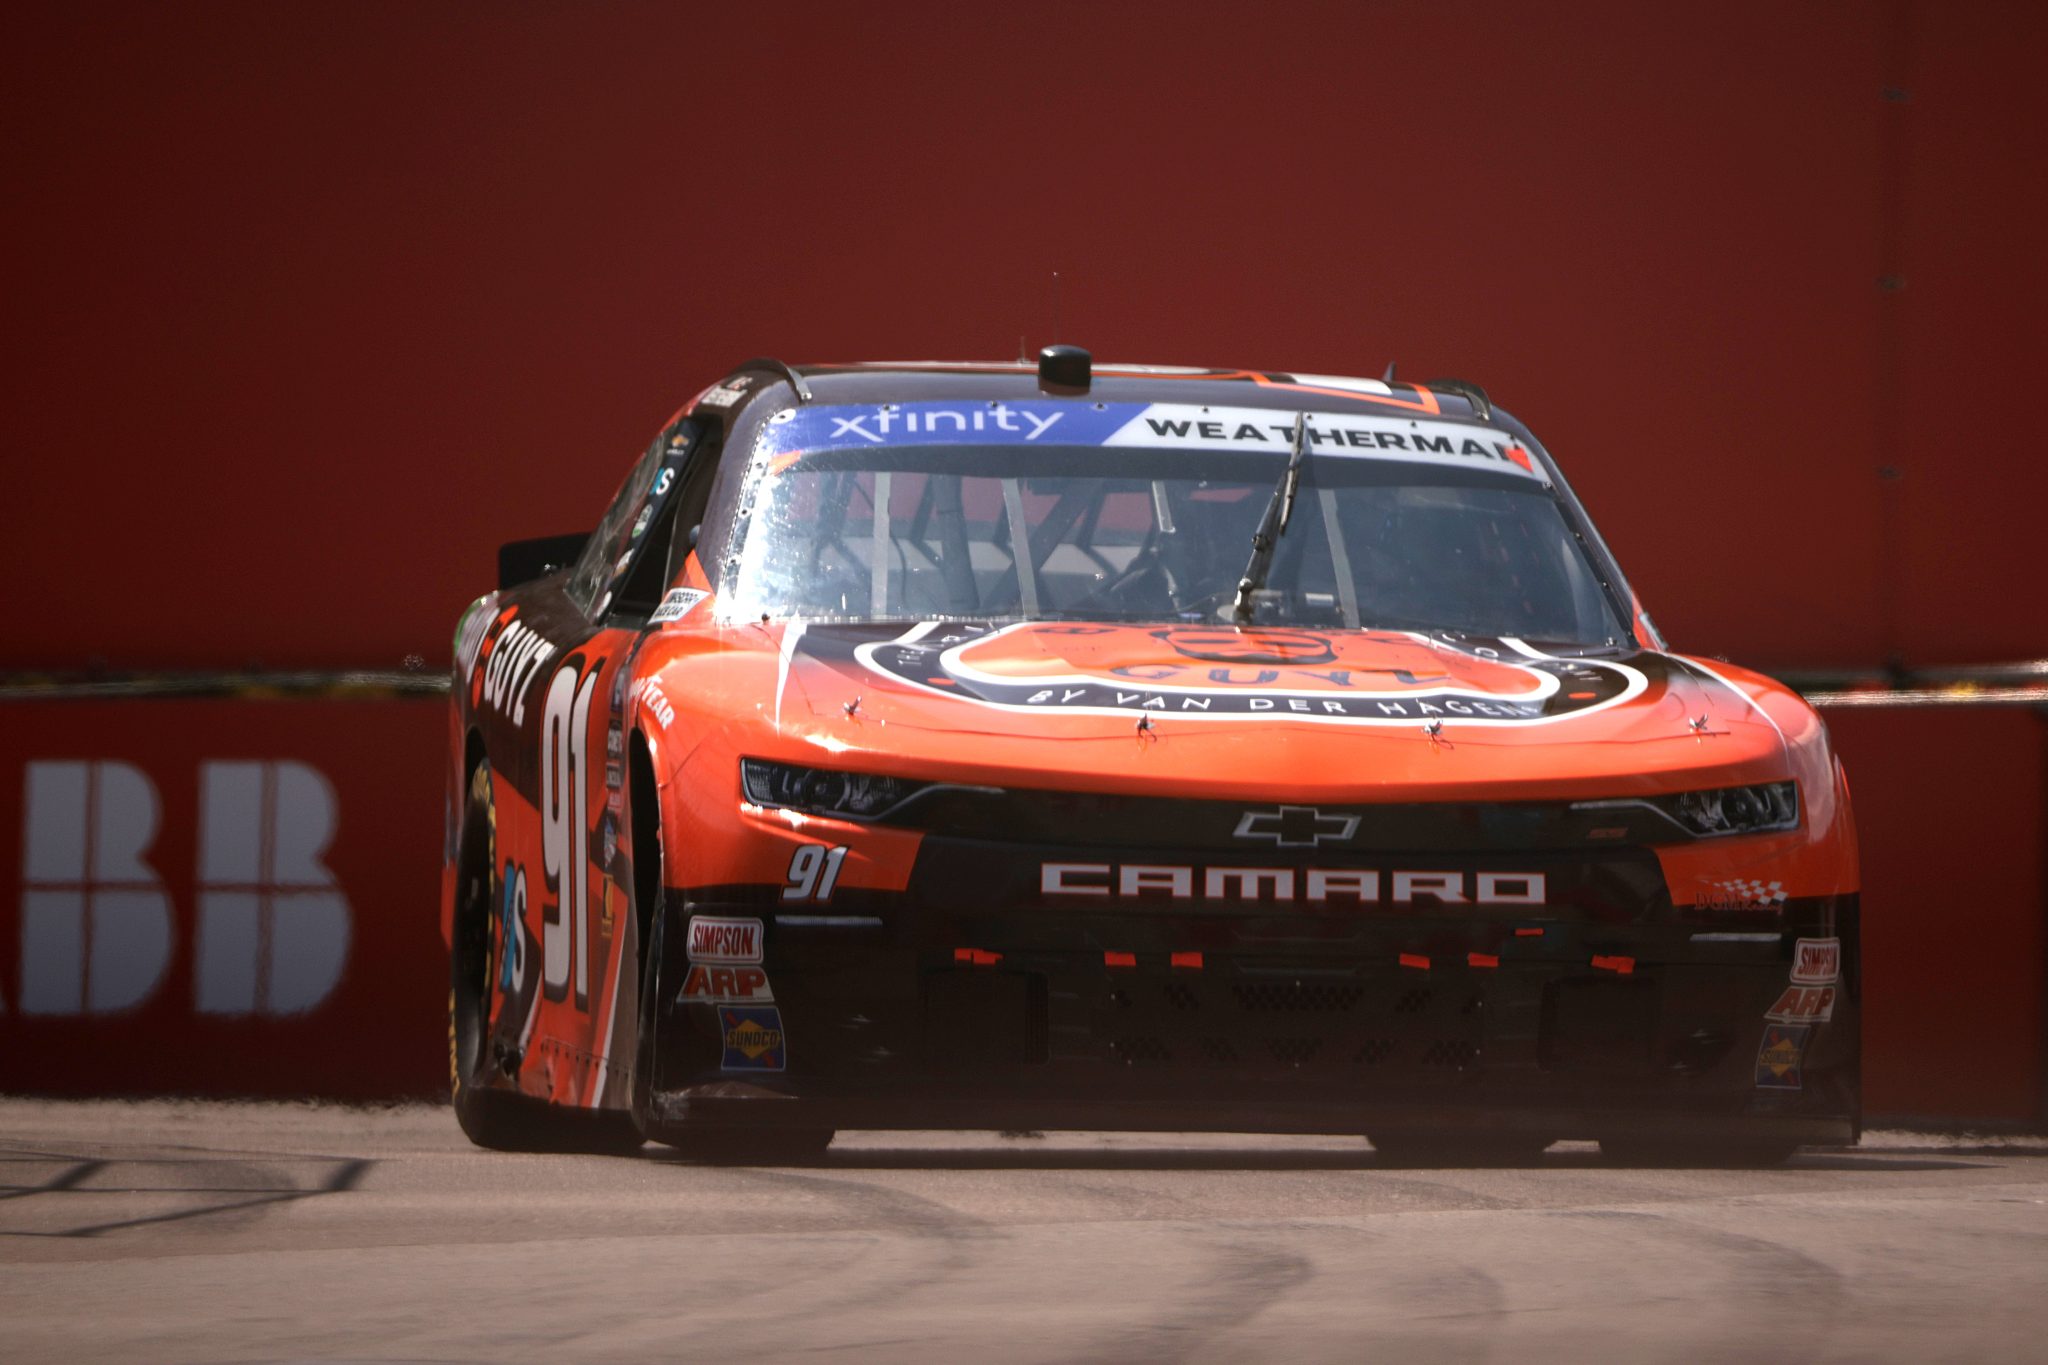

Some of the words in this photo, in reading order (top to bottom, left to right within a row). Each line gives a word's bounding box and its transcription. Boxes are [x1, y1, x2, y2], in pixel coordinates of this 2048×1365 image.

[830, 404, 1064, 442] xfinity
[630, 675, 675, 730] YEAR
[1027, 689, 1086, 704] BY
[1116, 692, 1211, 710] VAN
[1249, 697, 1347, 714] DER
[1376, 699, 1537, 718] HAGEN
[541, 664, 598, 997] 91
[0, 760, 352, 1018] BB
[782, 845, 847, 900] 91
[1041, 863, 1546, 904] CAMARO
[692, 925, 755, 956] SIMPSON
[682, 967, 766, 996] ARP
[1770, 987, 1835, 1016] ARP
[728, 1031, 780, 1047] SUNOCO
